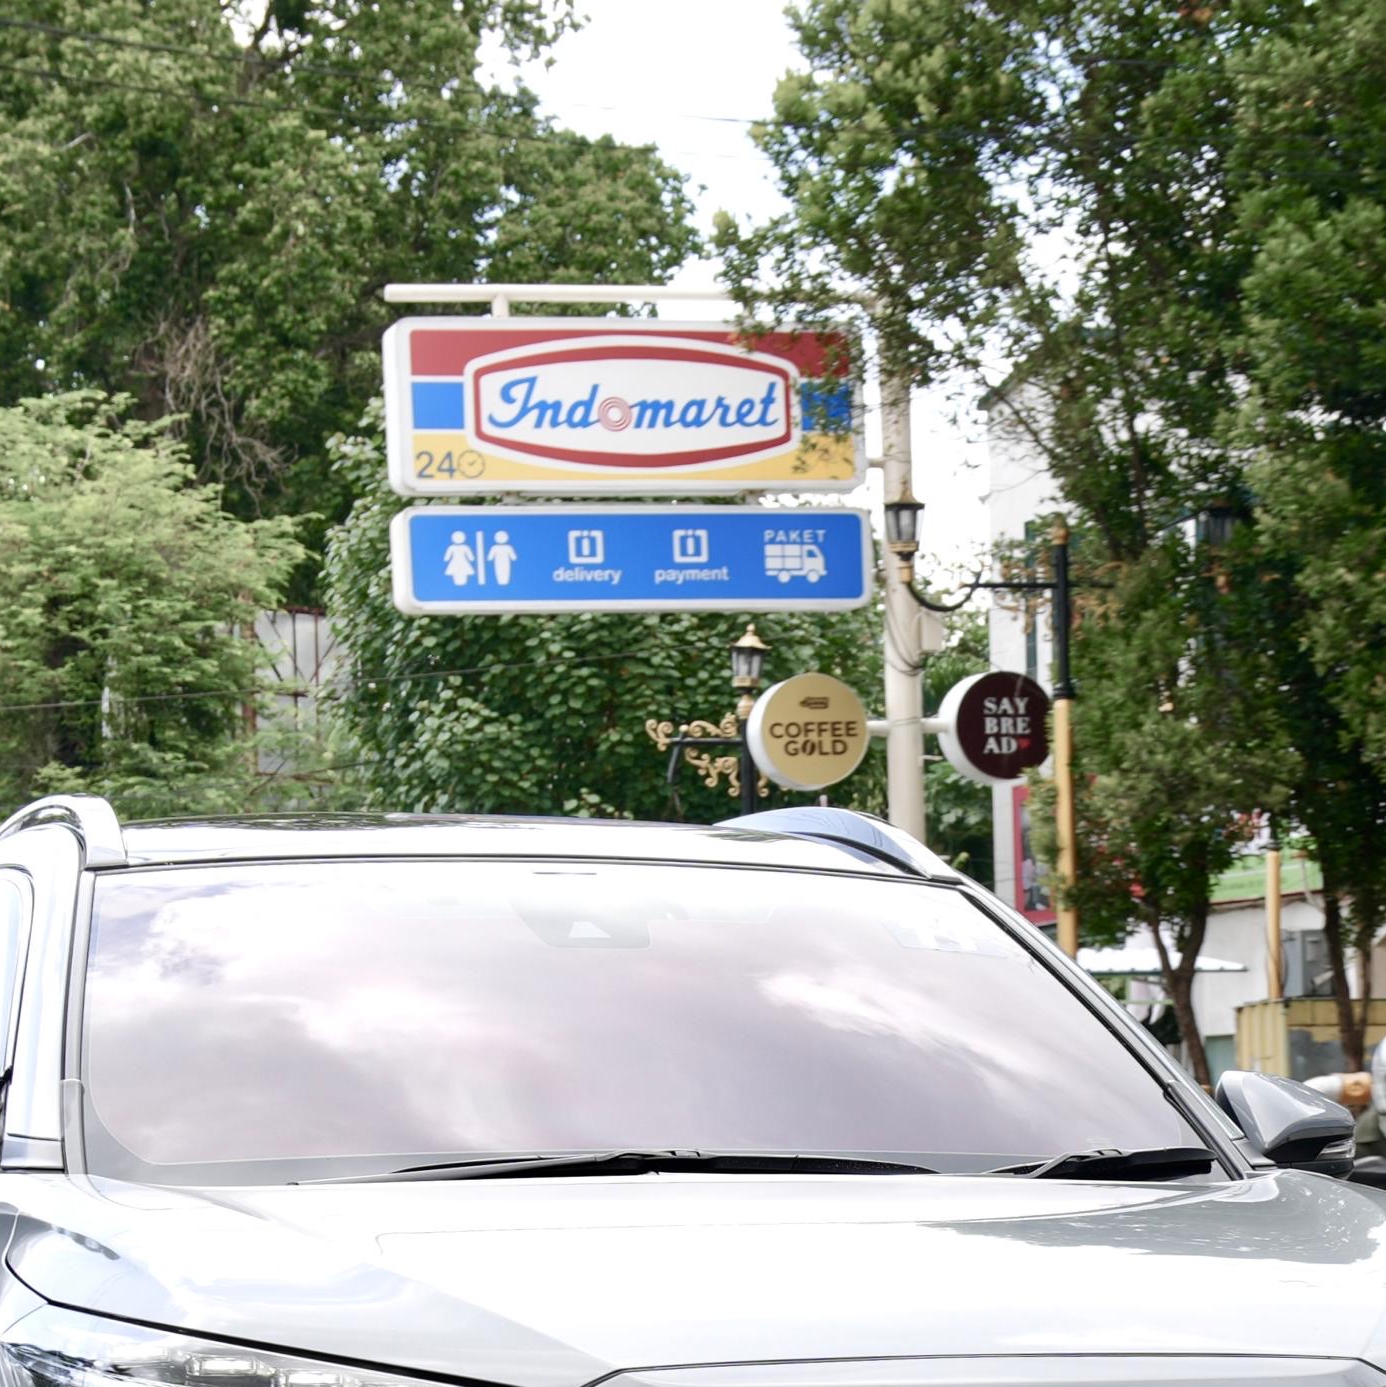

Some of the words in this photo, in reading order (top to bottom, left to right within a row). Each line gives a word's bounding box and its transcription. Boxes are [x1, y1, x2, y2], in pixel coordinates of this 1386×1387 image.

[488, 375, 779, 432] Indomaret
[415, 451, 456, 479] 24
[764, 529, 827, 543] PAKET
[552, 566, 622, 584] delivery
[654, 566, 729, 585] payment
[983, 697, 1029, 716] SAY
[769, 721, 858, 739] COFFEE
[983, 716, 1031, 735] BRE
[784, 738, 849, 757] GOLD
[983, 736, 1017, 755] AD
